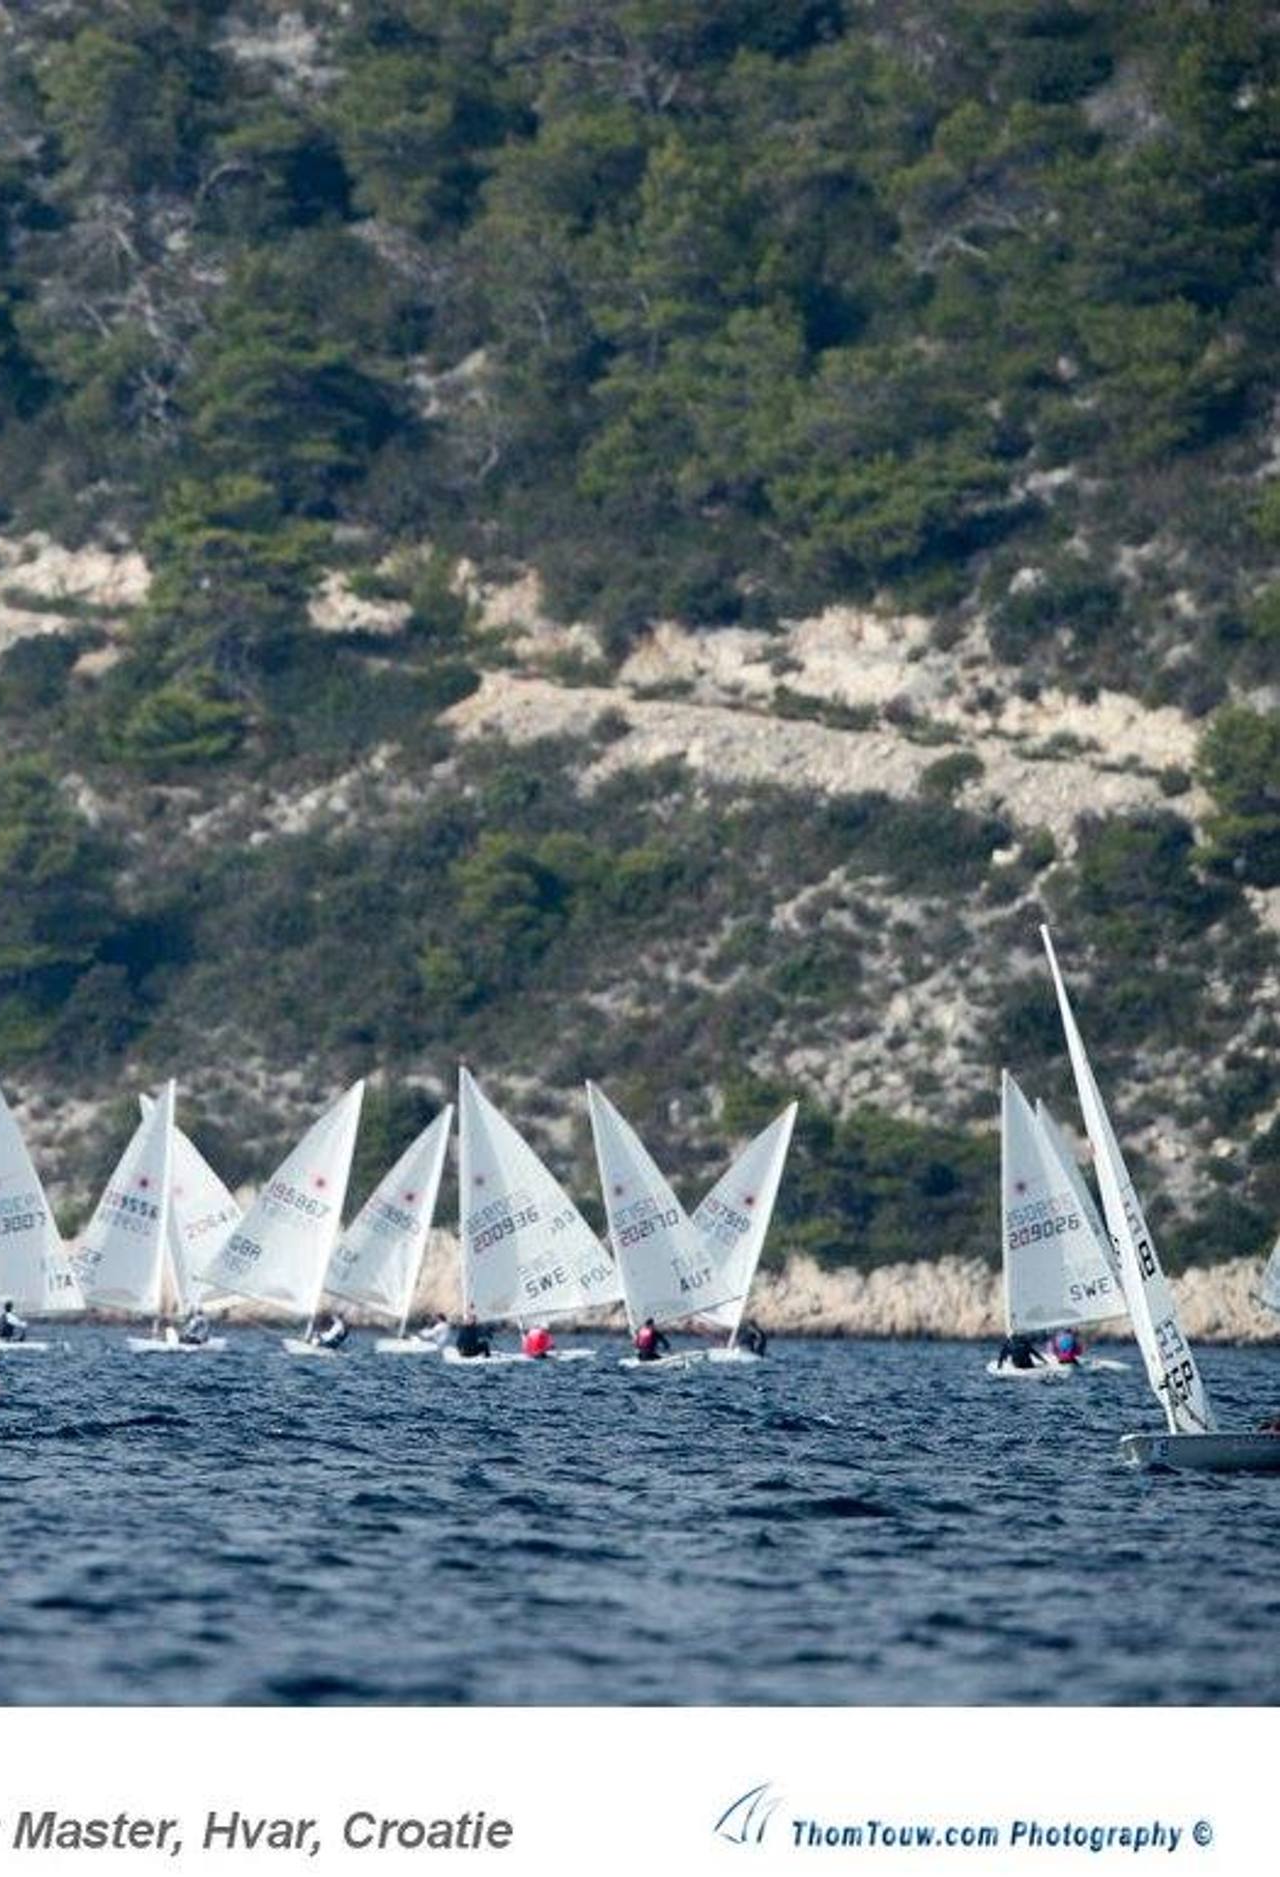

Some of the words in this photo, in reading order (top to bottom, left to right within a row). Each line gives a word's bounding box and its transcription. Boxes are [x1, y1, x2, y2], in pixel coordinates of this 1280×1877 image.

[1008, 1212, 1080, 1251] 209026
[524, 1265, 570, 1300] SWE
[1069, 1276, 1112, 1302] SWE
